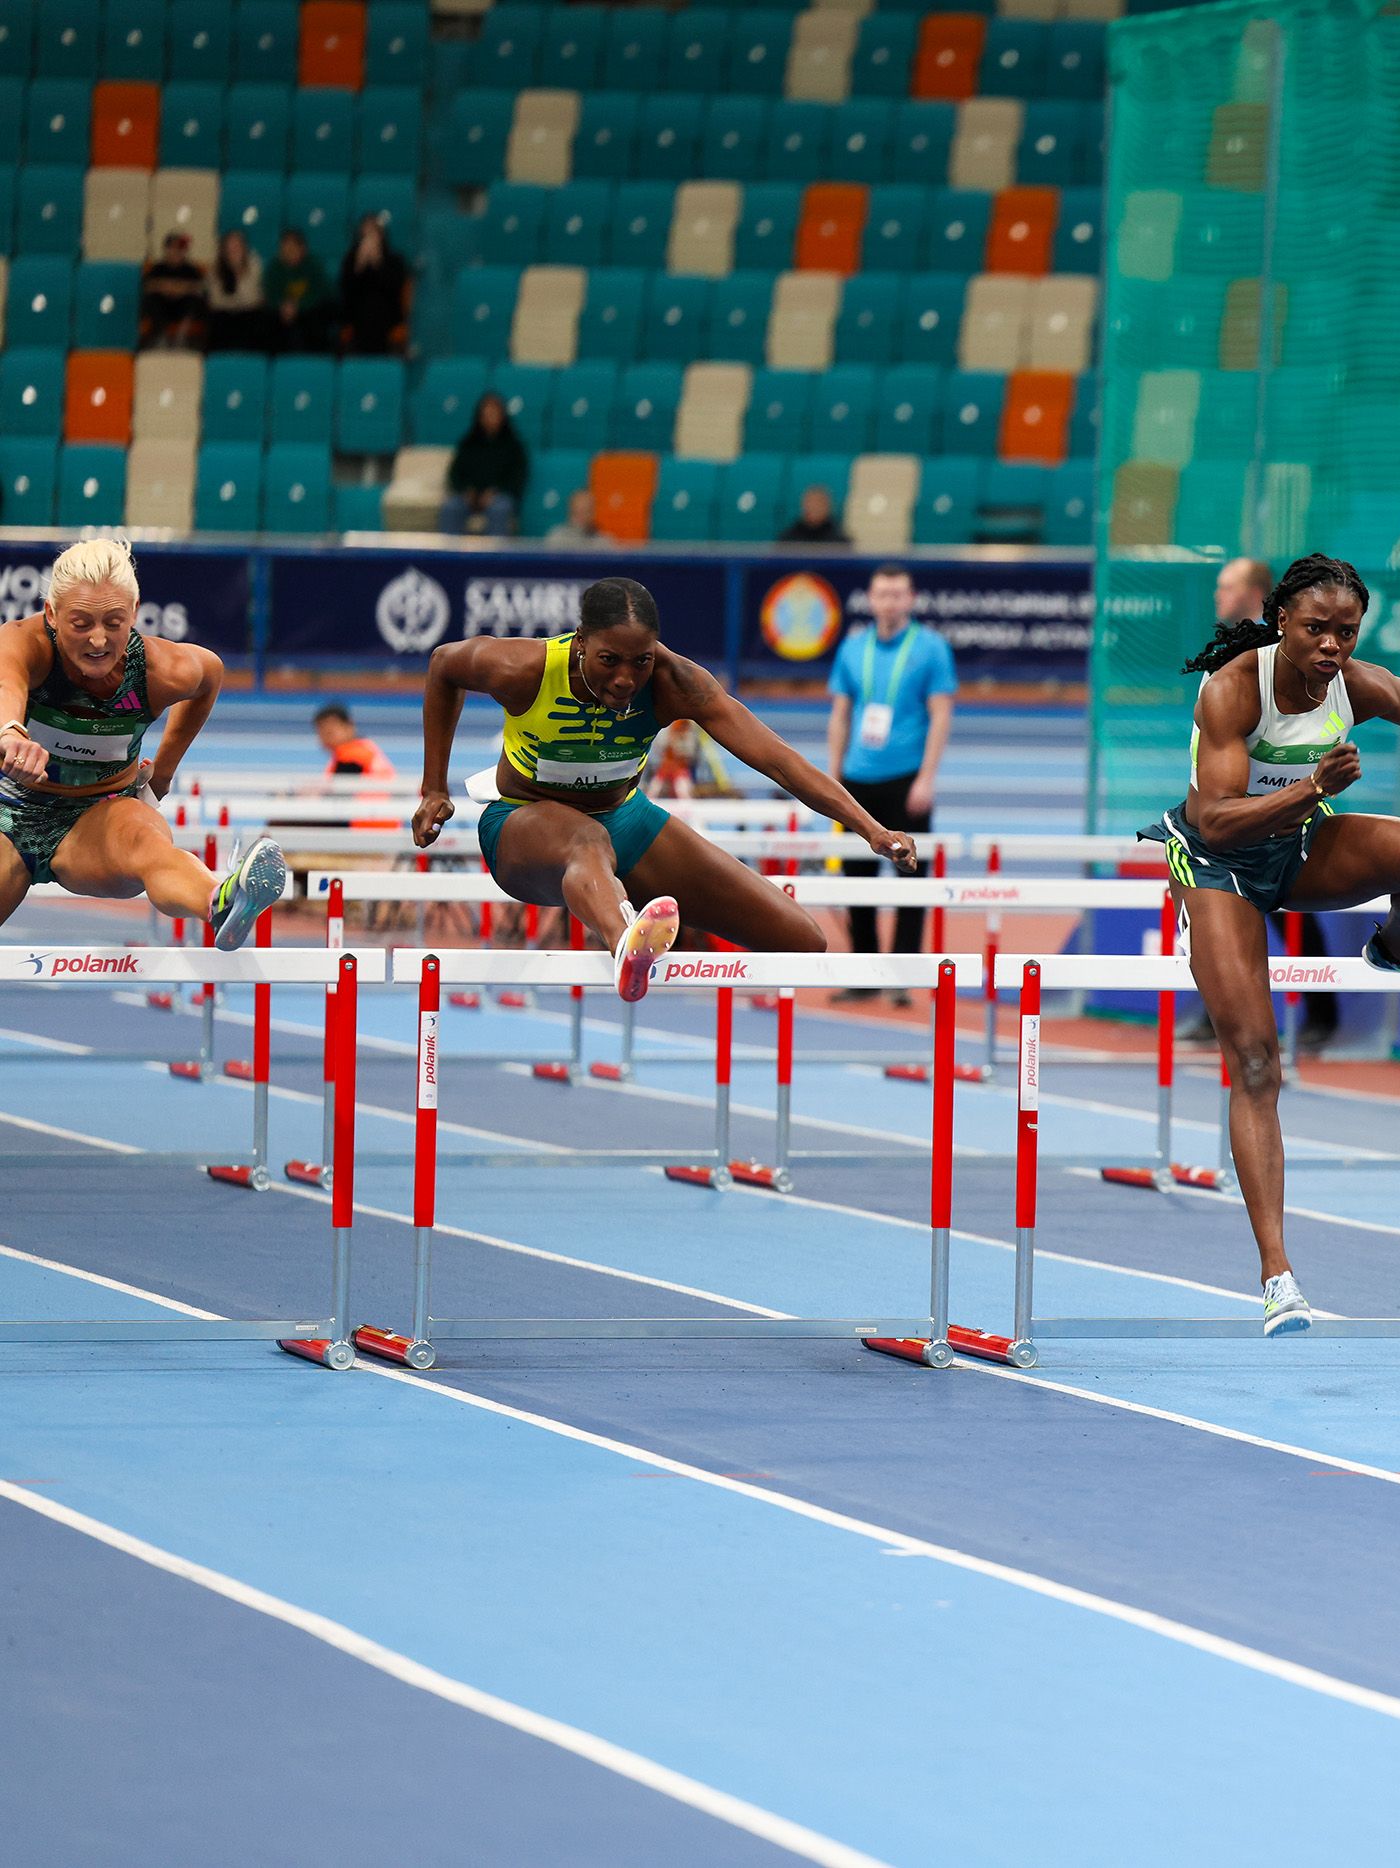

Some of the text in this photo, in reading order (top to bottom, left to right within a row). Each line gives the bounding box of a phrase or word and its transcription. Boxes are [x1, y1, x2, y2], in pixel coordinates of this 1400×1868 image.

[55, 742, 97, 756] LAVIN
[1257, 775, 1301, 788] AMU
[51, 954, 140, 977] polanik
[664, 959, 748, 982] polanik
[424, 1035, 436, 1084] polanik
[1025, 1038, 1037, 1087] polanik
